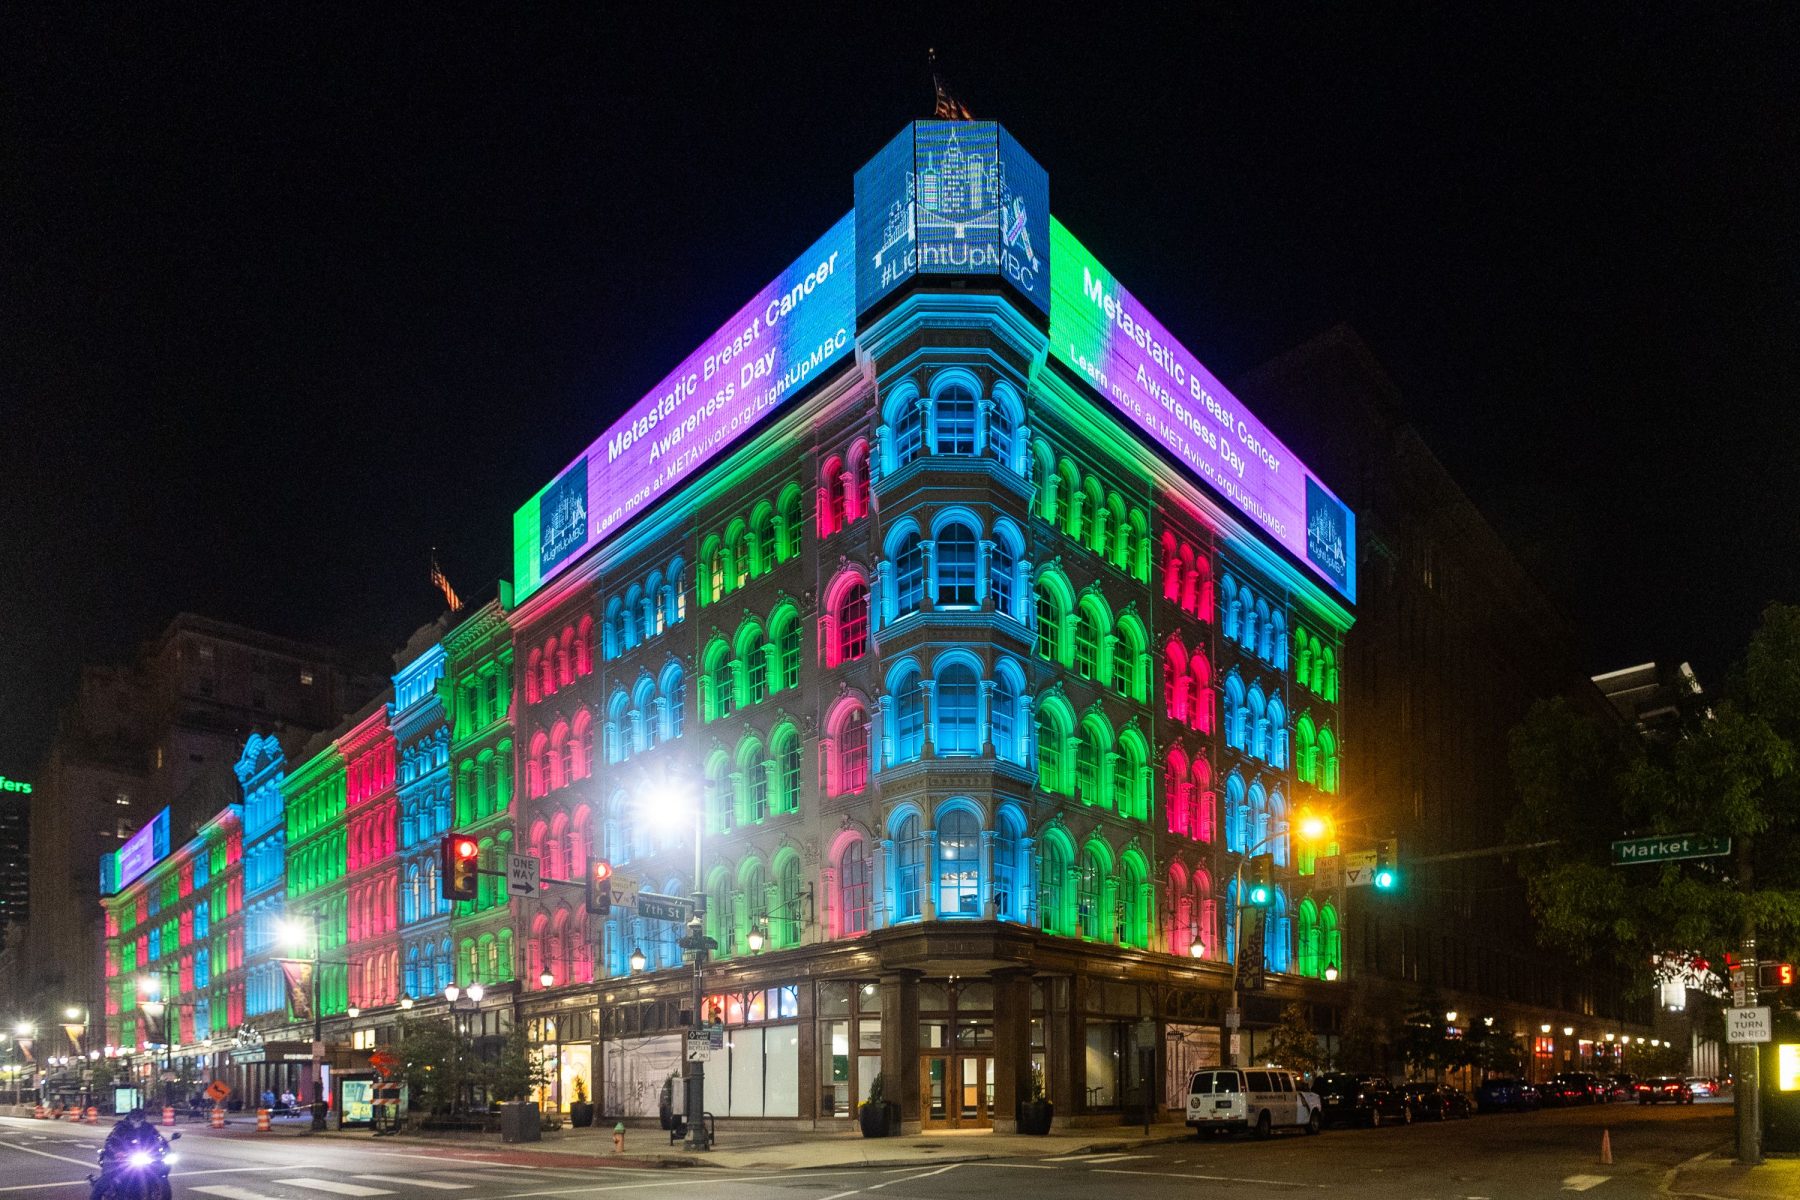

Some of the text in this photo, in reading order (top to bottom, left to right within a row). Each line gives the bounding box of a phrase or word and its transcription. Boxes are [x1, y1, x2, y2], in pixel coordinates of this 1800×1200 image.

[881, 242, 1034, 292] #LightUpMBC
[607, 251, 838, 464] Metastatic Breast Cancer
[1083, 266, 1280, 473] Metastatic Breast Cancer
[1070, 343, 1108, 389] Learn
[1112, 383, 1141, 416] more
[1145, 413, 1157, 430] at
[650, 347, 776, 464] Awareness Day
[1136, 363, 1245, 479] Awareness Day
[596, 328, 847, 534] Learn more at METAvivor.org/LightUpMBC
[513, 858, 534, 870] ONE
[1622, 838, 1719, 858] Market t
[513, 868, 535, 880] WAY
[644, 903, 680, 919] 7th St
[1781, 966, 1791, 984] 5
[1730, 1030, 1766, 1039] ON RED
[1734, 1021, 1763, 1029] TURN
